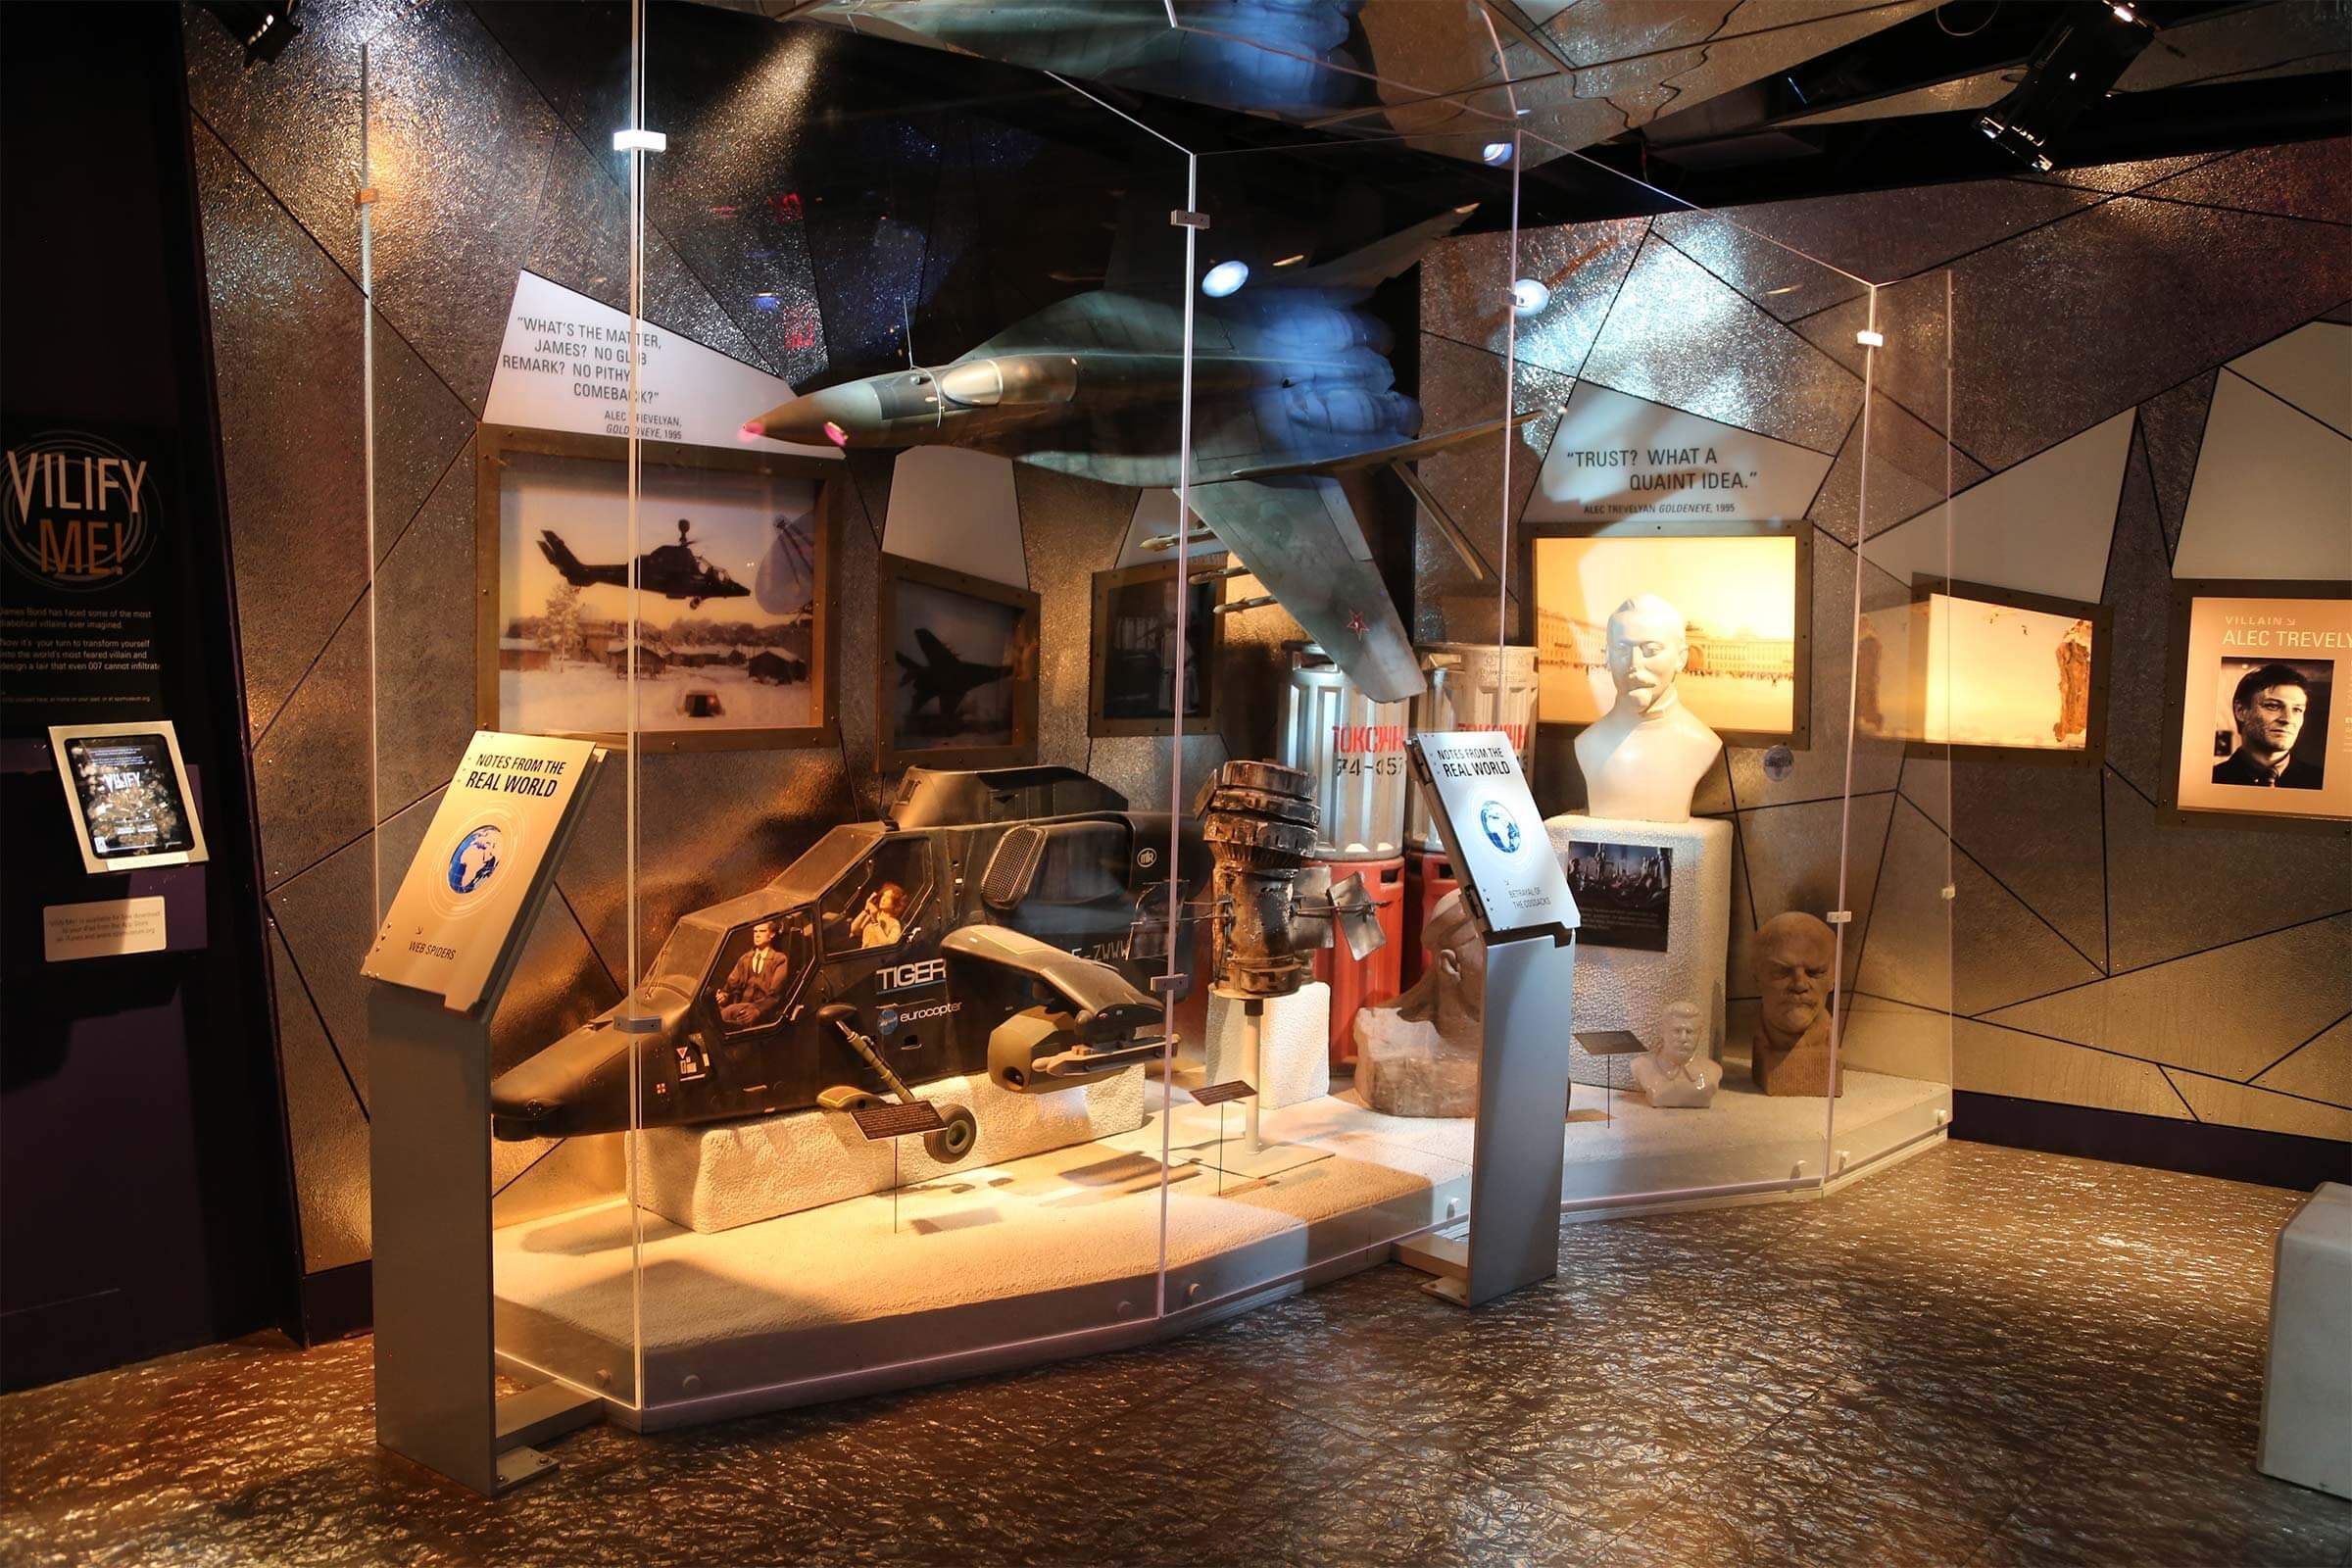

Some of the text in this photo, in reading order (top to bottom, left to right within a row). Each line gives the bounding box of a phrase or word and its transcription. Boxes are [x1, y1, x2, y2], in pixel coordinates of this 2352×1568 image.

[578, 324, 602, 340] THE
[534, 339, 648, 366] JAMES? NO GLB
[503, 355, 630, 381] REMARK? NO PITHY
[605, 411, 682, 427] ALEC REVELYAN,
[606, 423, 682, 440] GOLDNEYE, 1995
[1567, 448, 1718, 467] “TRUST? WHAT A
[7, 450, 148, 525] VILIFY
[1630, 471, 1758, 491] QUAINT IDEA.”
[1583, 503, 1735, 514] ALEC TREVELYAN GOLDENEYE, 1995
[39, 518, 123, 576] ME!
[26, 607, 47, 616] Bond
[88, 610, 109, 618] some
[119, 609, 131, 618] the
[132, 610, 152, 618] most
[2225, 615, 2282, 626] VILLAIN
[35, 640, 54, 650] your
[56, 640, 72, 649] turn
[73, 640, 81, 649] to
[83, 639, 119, 649] transform
[121, 639, 150, 650] yourself
[2222, 629, 2270, 647] ALEC
[18, 650, 31, 659] the
[63, 651, 82, 660] most
[83, 650, 108, 660] feared
[109, 651, 131, 660] villain
[132, 651, 147, 660] and
[50, 662, 67, 670] that
[68, 662, 86, 671] even
[104, 662, 129, 671] cannot
[1437, 747, 1504, 760] NOTES FROM THE
[475, 754, 566, 775] NOTES FROM THE
[1443, 761, 1473, 777] REAL
[1473, 760, 1511, 776] WORLD
[466, 770, 558, 798] REAL WORLD
[409, 941, 457, 960] WEB SPIDERS
[876, 958, 947, 990] TIGER
[900, 1002, 962, 1022] eurocopter
